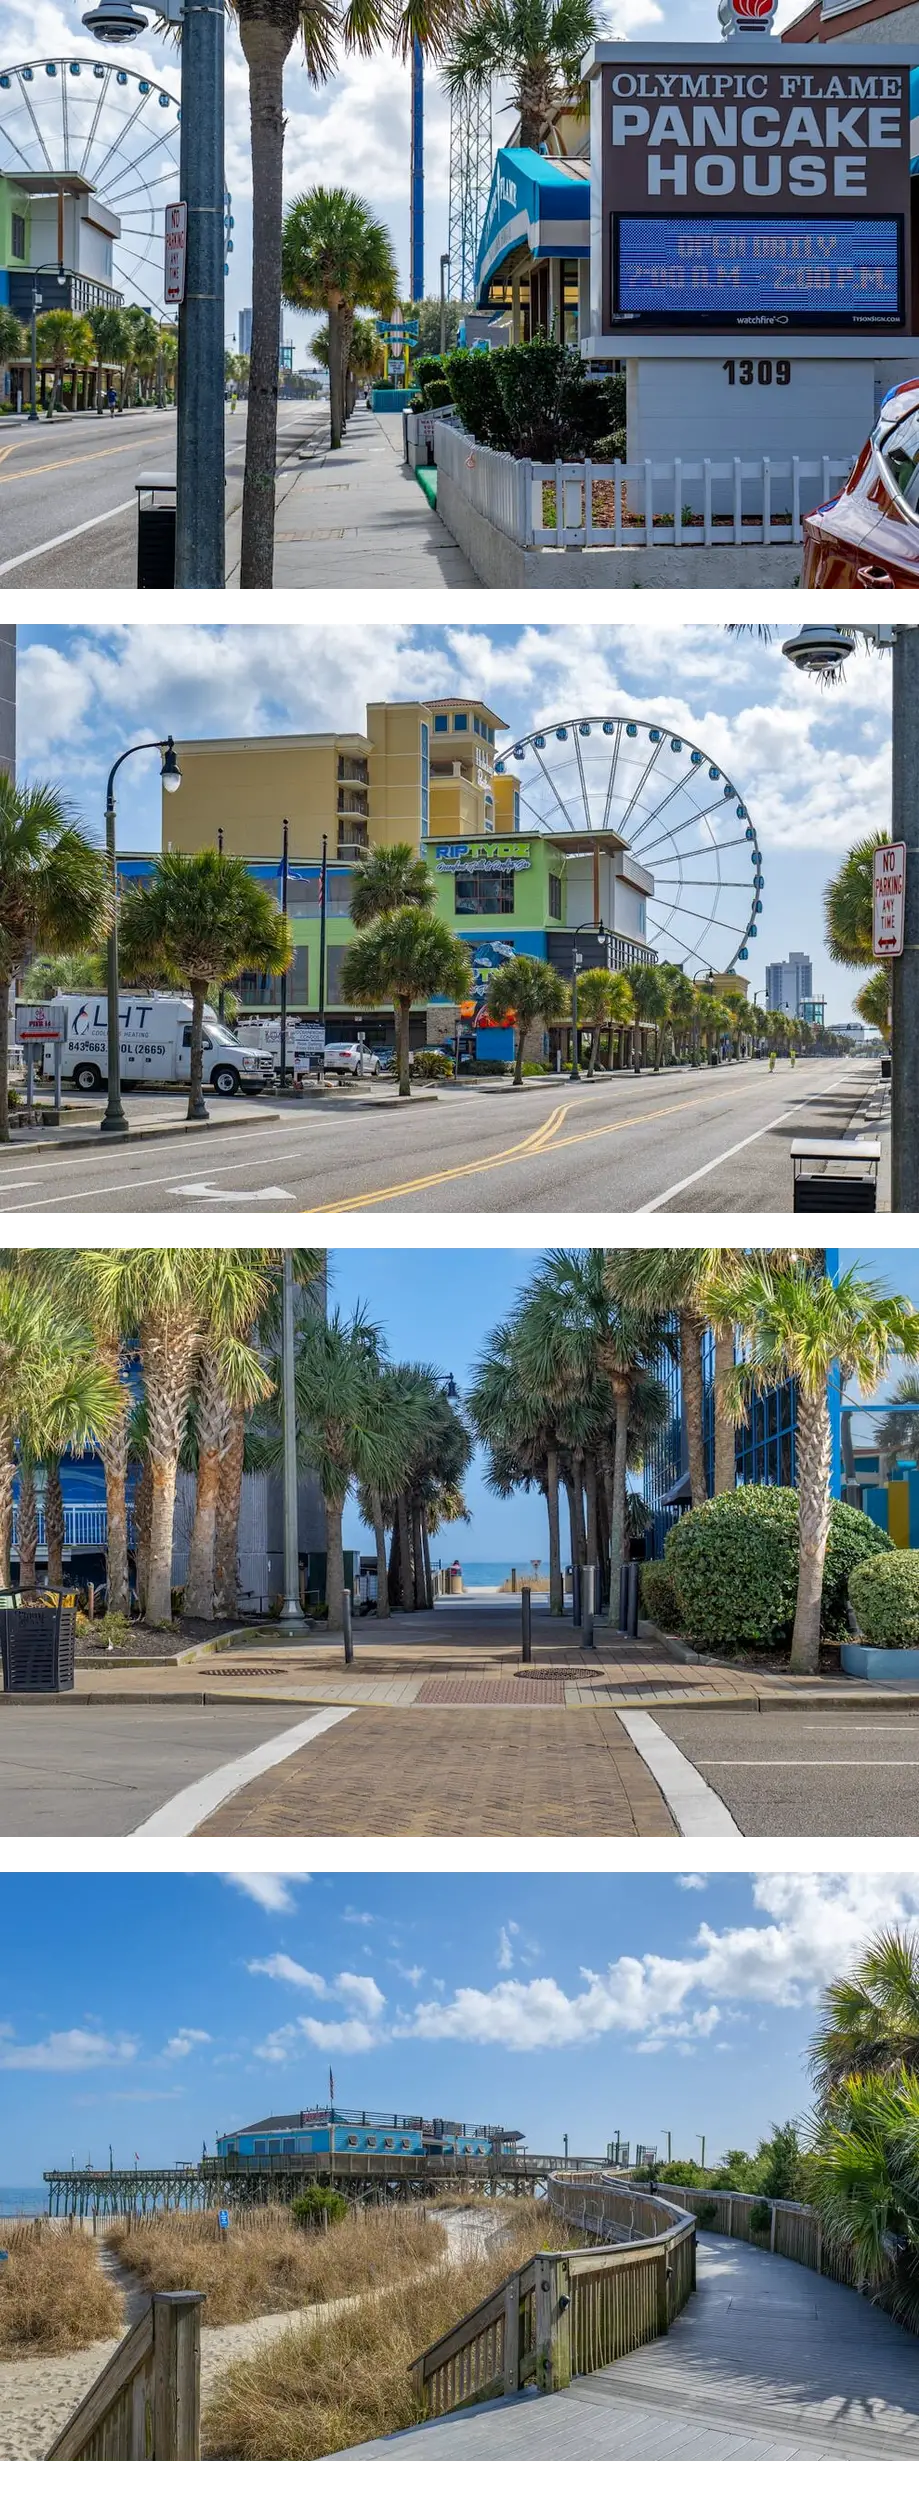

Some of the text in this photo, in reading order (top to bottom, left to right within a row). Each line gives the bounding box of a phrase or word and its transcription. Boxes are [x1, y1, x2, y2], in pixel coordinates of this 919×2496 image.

[612, 73, 903, 100] OLYMPIC FLAME
[611, 105, 903, 148] PANCAKE
[647, 154, 868, 197] HOUSE
[171, 208, 180, 229] NO
[166, 231, 184, 250] PARKING
[677, 235, 837, 259] OPEN DAILY
[170, 252, 179, 265] ANY
[169, 266, 180, 280] TIME
[736, 315, 775, 325] watchfire
[722, 359, 791, 386] 1309
[435, 843, 531, 860] RIPTYDZ
[883, 851, 896, 873] NO
[875, 875, 903, 898] PARKING
[882, 898, 895, 913] ANY
[881, 915, 896, 929] TIME
[93, 1004, 153, 1029] LHT
[123, 1030, 150, 1039] HEATING
[134, 1044, 166, 1057] (2665)
